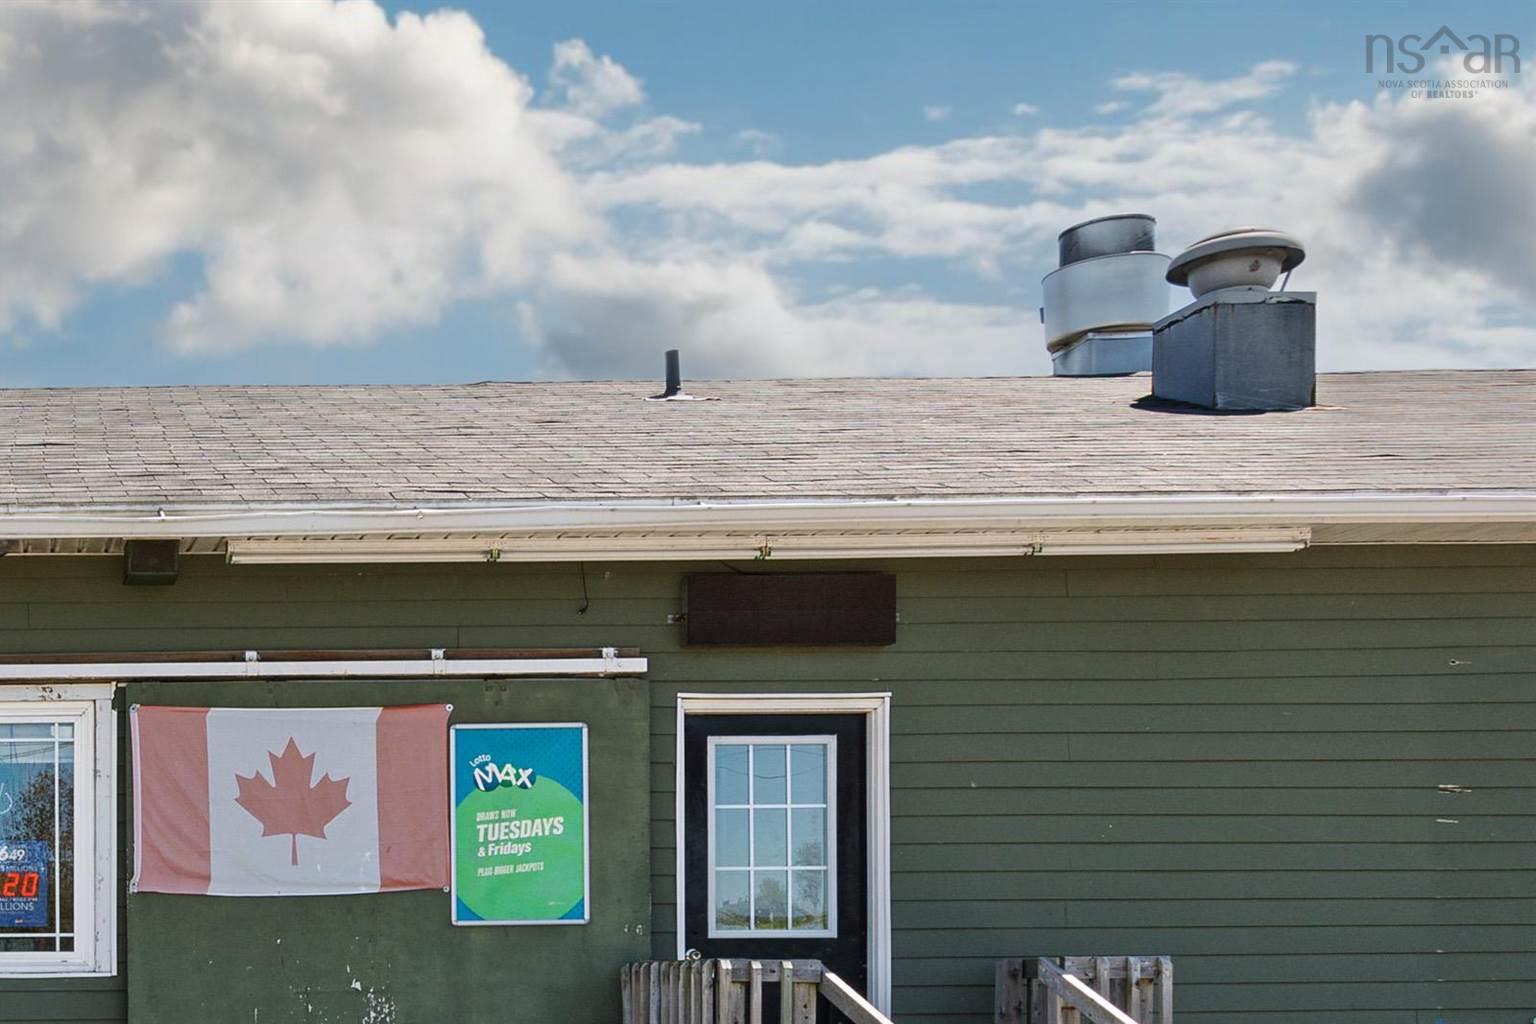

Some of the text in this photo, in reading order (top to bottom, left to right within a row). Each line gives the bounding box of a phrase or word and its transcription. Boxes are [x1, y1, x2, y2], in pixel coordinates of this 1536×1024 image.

[469, 754, 492, 768] Lotto
[474, 762, 533, 791] MAX
[476, 816, 565, 842] TUESDAYS
[477, 842, 532, 857] & Fridays
[2, 871, 39, 897] 20
